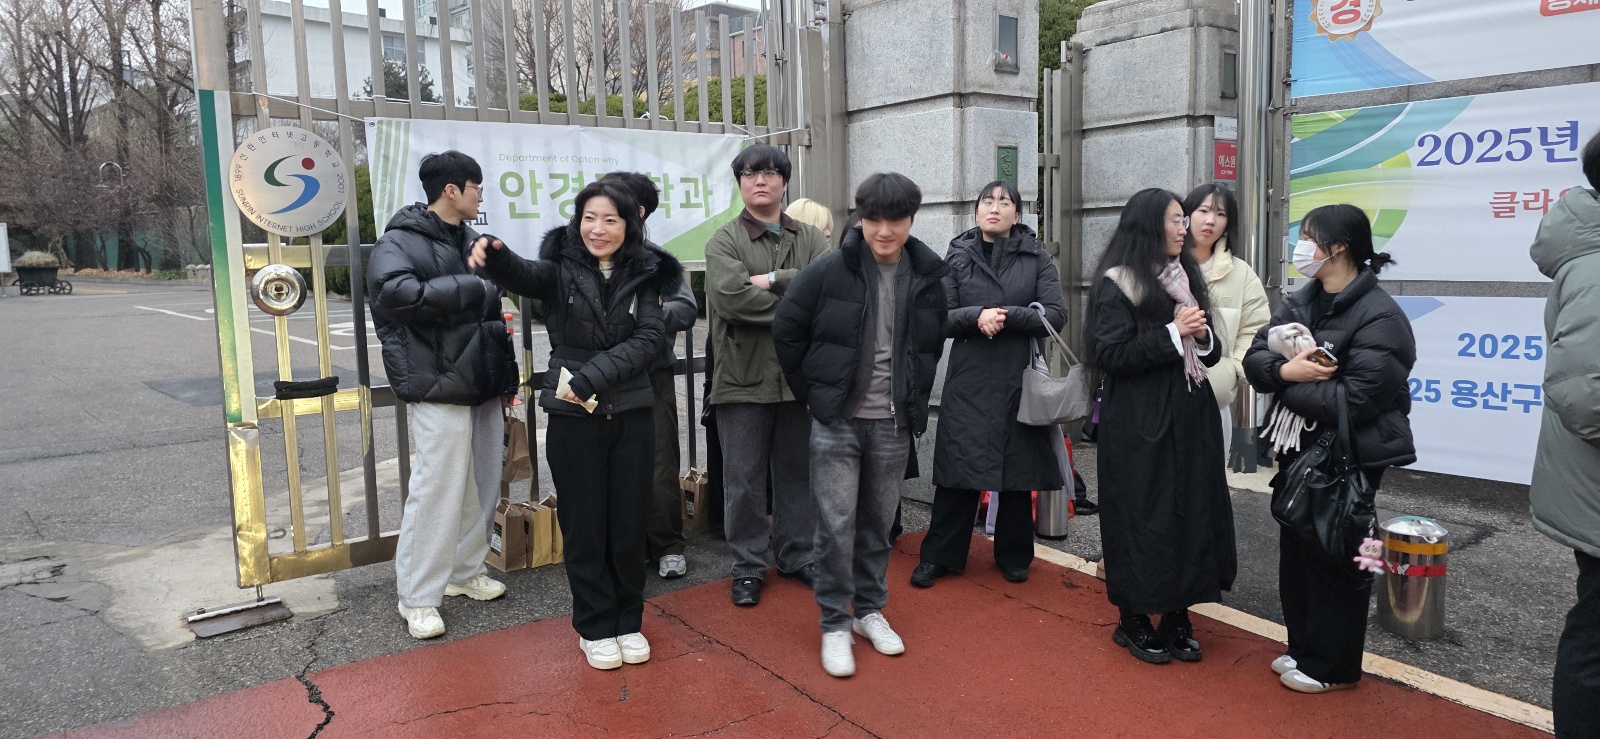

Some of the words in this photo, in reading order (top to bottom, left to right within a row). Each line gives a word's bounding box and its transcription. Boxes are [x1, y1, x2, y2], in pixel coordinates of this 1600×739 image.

[234, 164, 243, 182] 1899
[239, 131, 340, 168] 선린인터넷고등학교
[498, 153, 557, 164] Department
[559, 155, 569, 163] of
[571, 155, 619, 166] Optometry
[1416, 120, 1579, 167] 2025년
[236, 188, 257, 215] SUNRIN
[255, 214, 293, 233] INTERNET
[295, 223, 317, 233] HIGH
[317, 201, 343, 226] SCHOOL
[500, 170, 713, 219] 안경학과
[1489, 188, 1571, 218] 클라
[1457, 333, 1544, 361] 2025
[1451, 379, 1542, 413] 용산구
